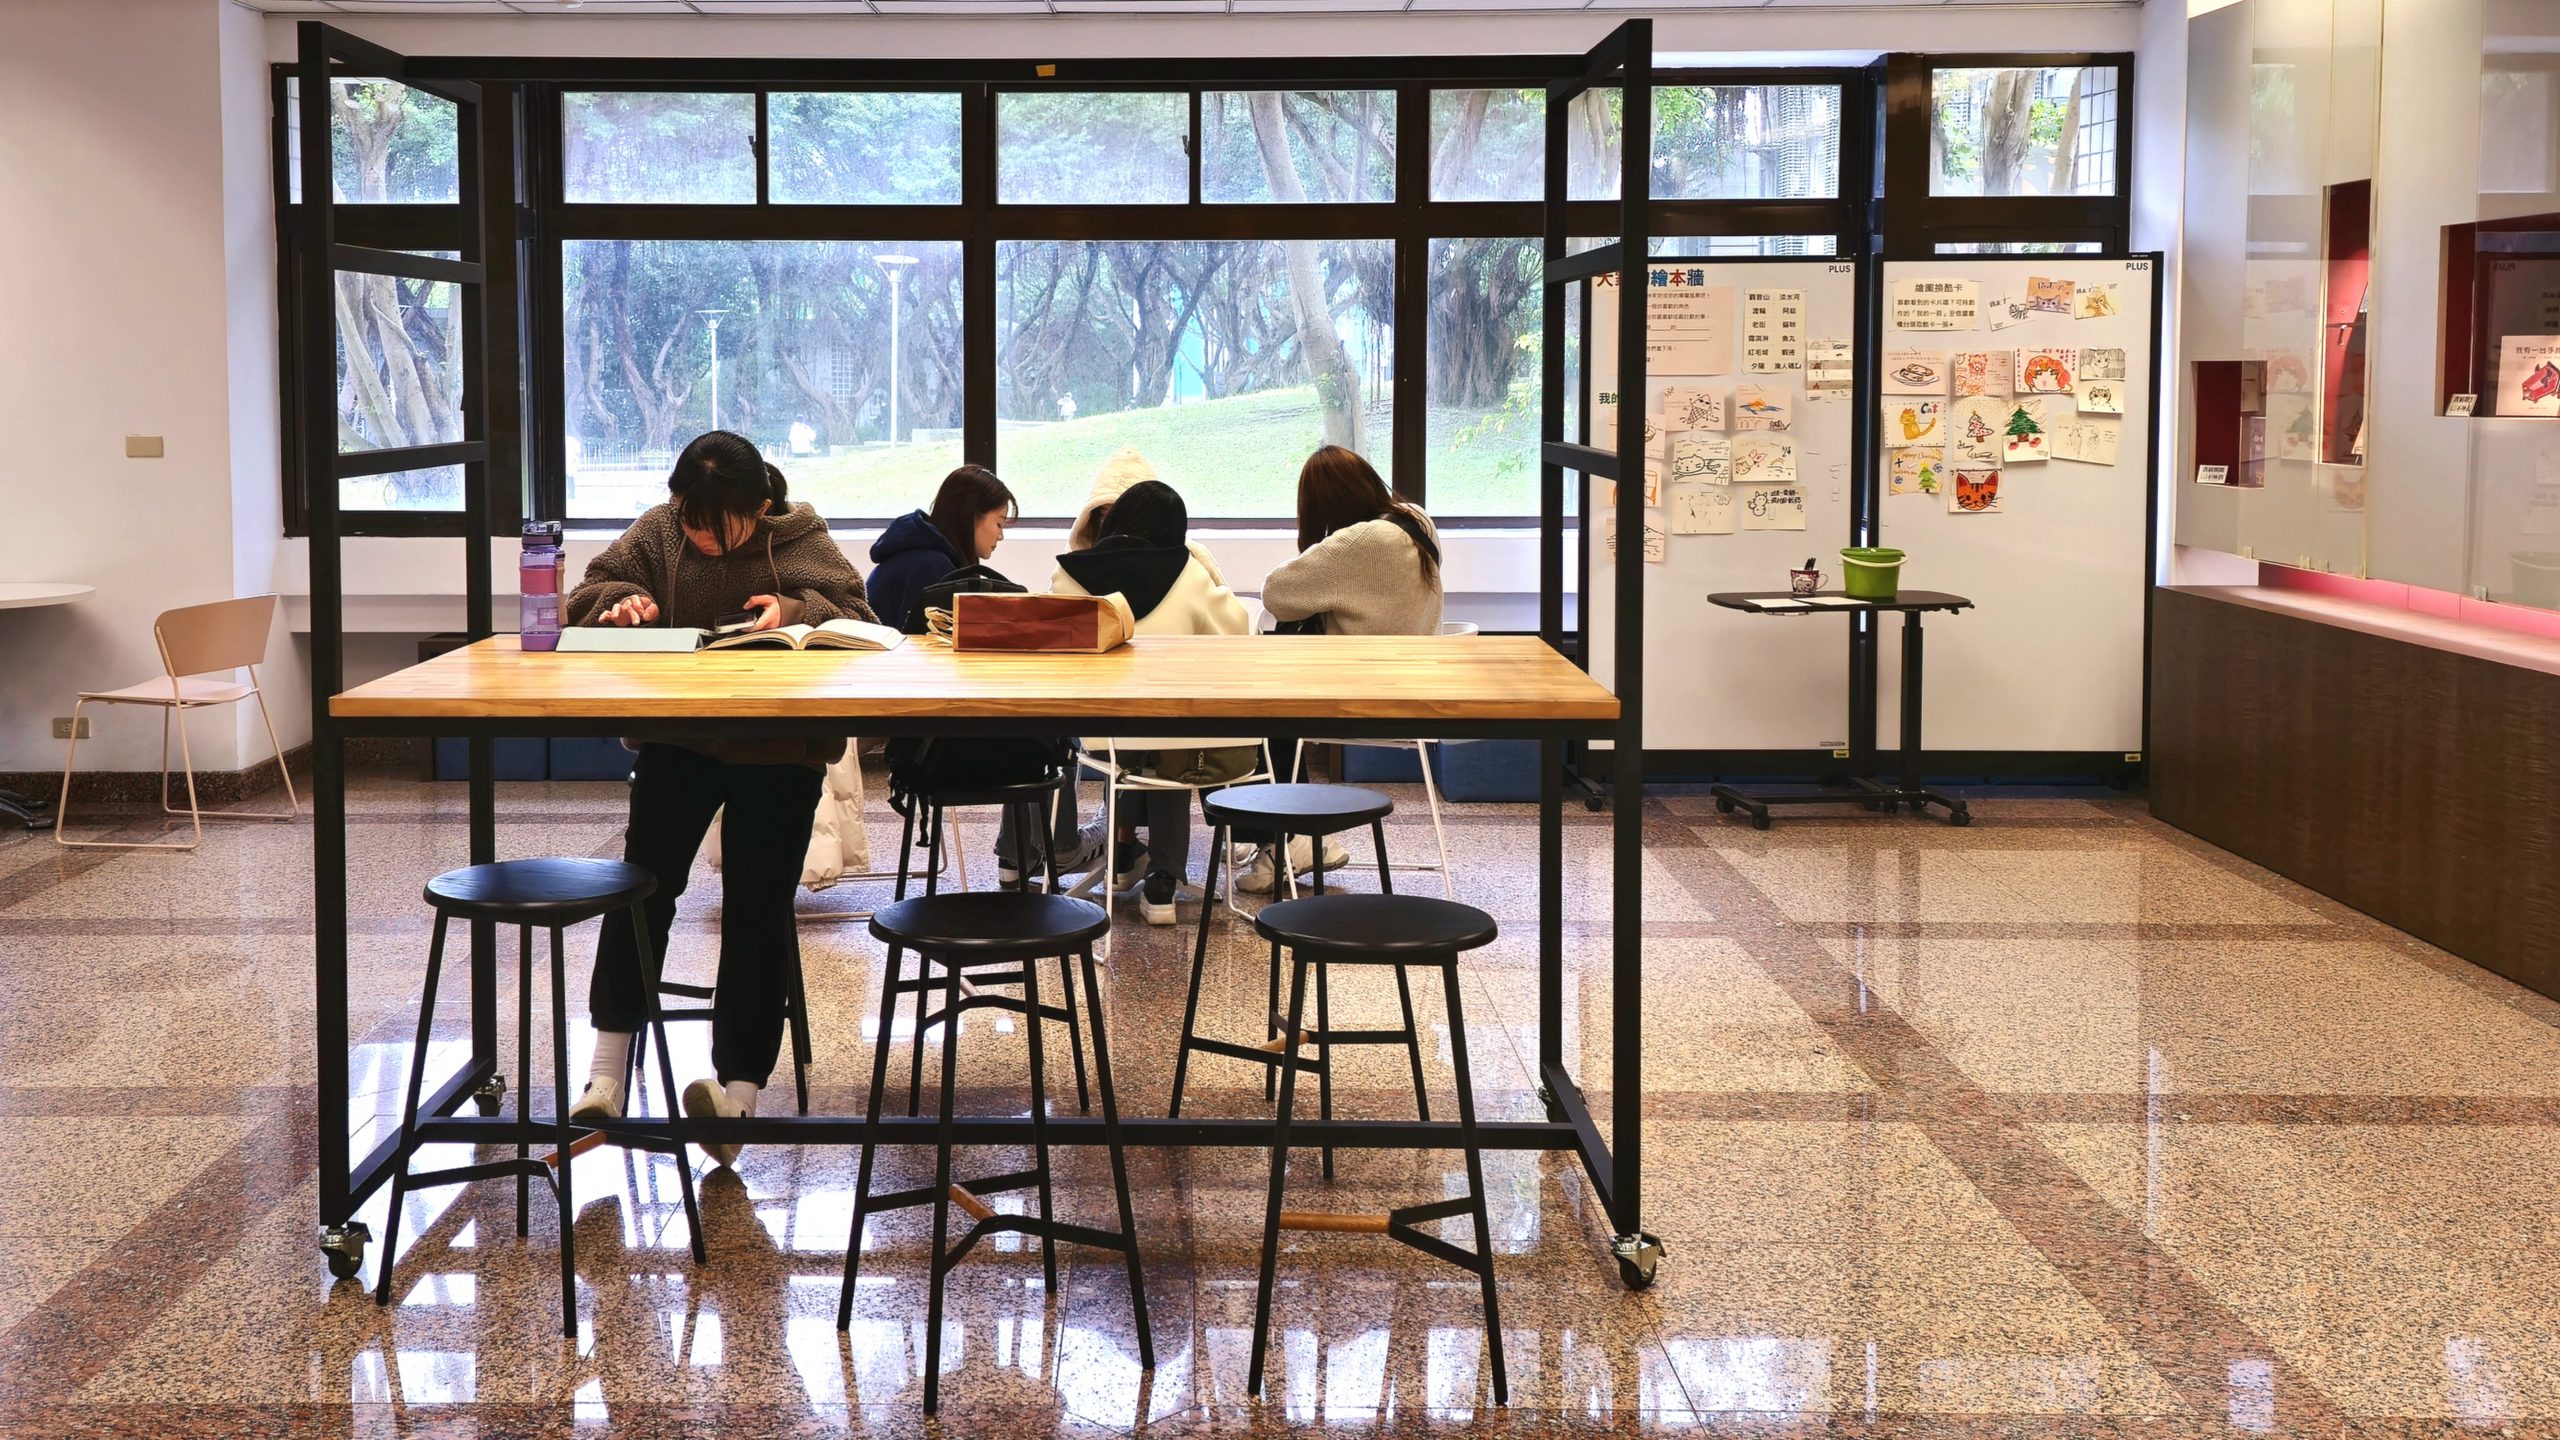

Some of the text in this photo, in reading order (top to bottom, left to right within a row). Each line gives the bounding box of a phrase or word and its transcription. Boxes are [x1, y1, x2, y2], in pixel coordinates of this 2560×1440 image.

[1828, 265, 1851, 273] PLUS
[2126, 262, 2148, 271] PLUS
[1749, 293, 1770, 301] 觀音山
[1779, 293, 1800, 301] 淡水河
[1921, 403, 1940, 414] Cat
